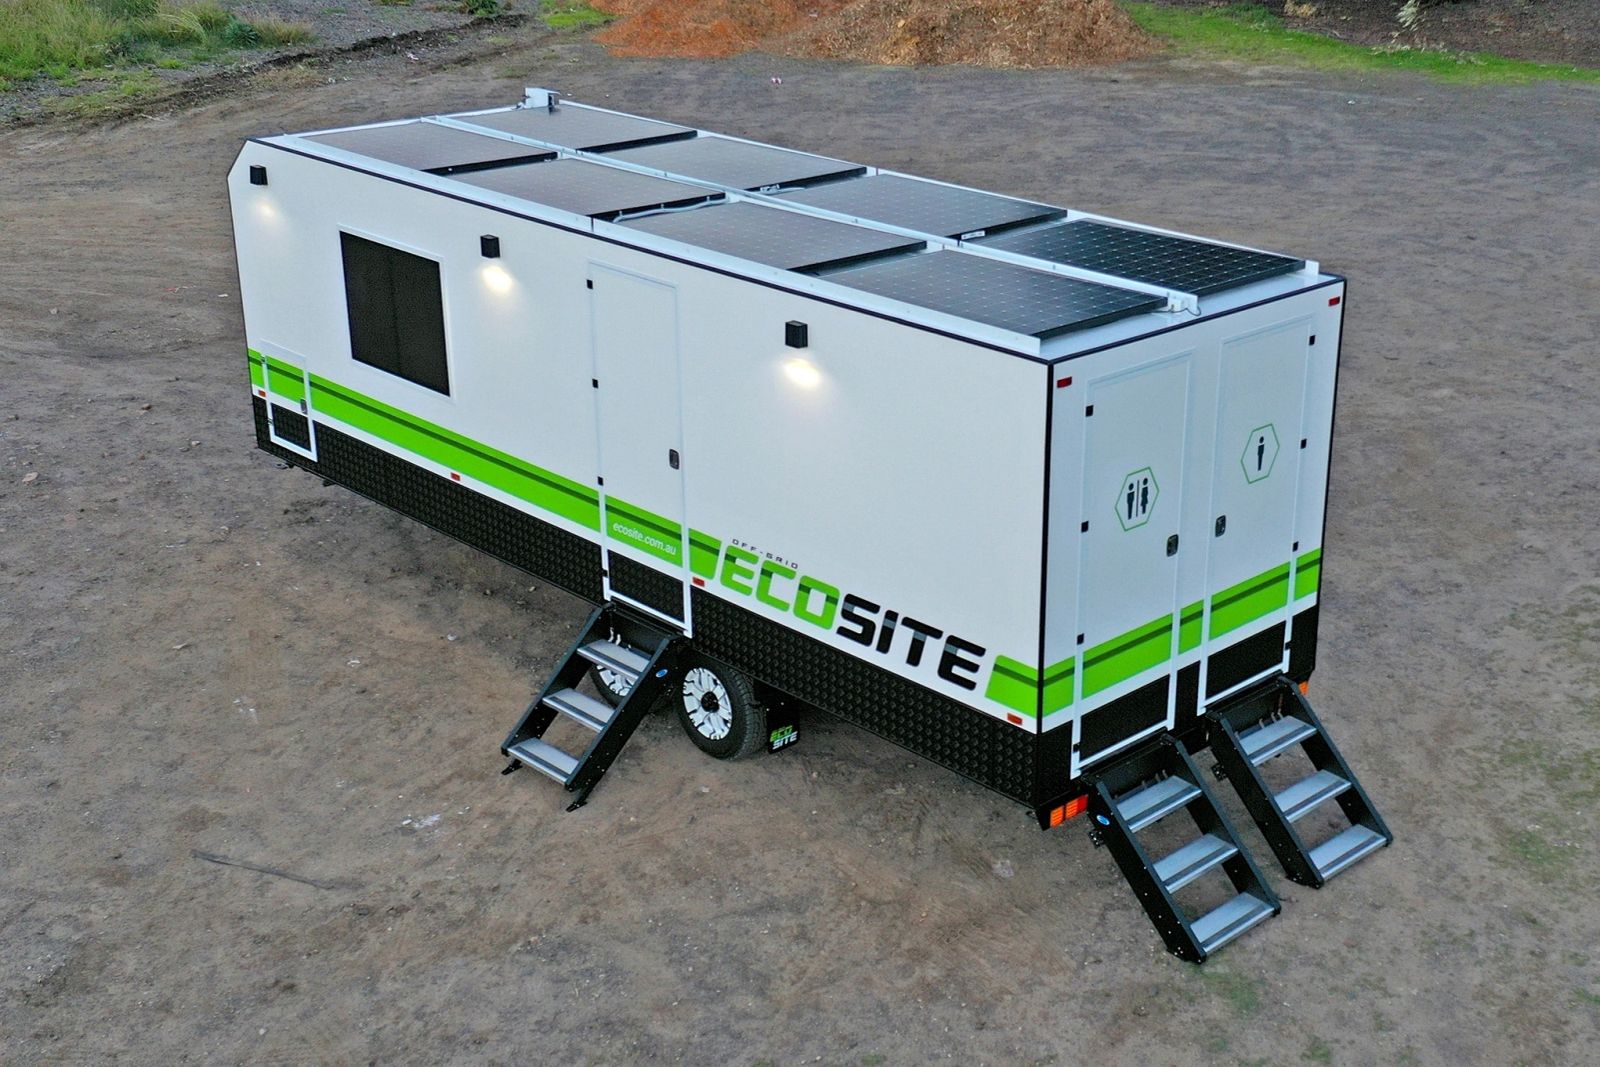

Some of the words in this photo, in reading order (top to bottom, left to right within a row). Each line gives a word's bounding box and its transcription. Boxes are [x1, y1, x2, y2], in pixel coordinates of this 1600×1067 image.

[612, 522, 677, 556] ecosite.com.au
[732, 538, 798, 569] OFF-GRID
[719, 545, 986, 691] ECOSITE
[770, 725, 793, 742] ECO
[772, 731, 798, 750] SITE
